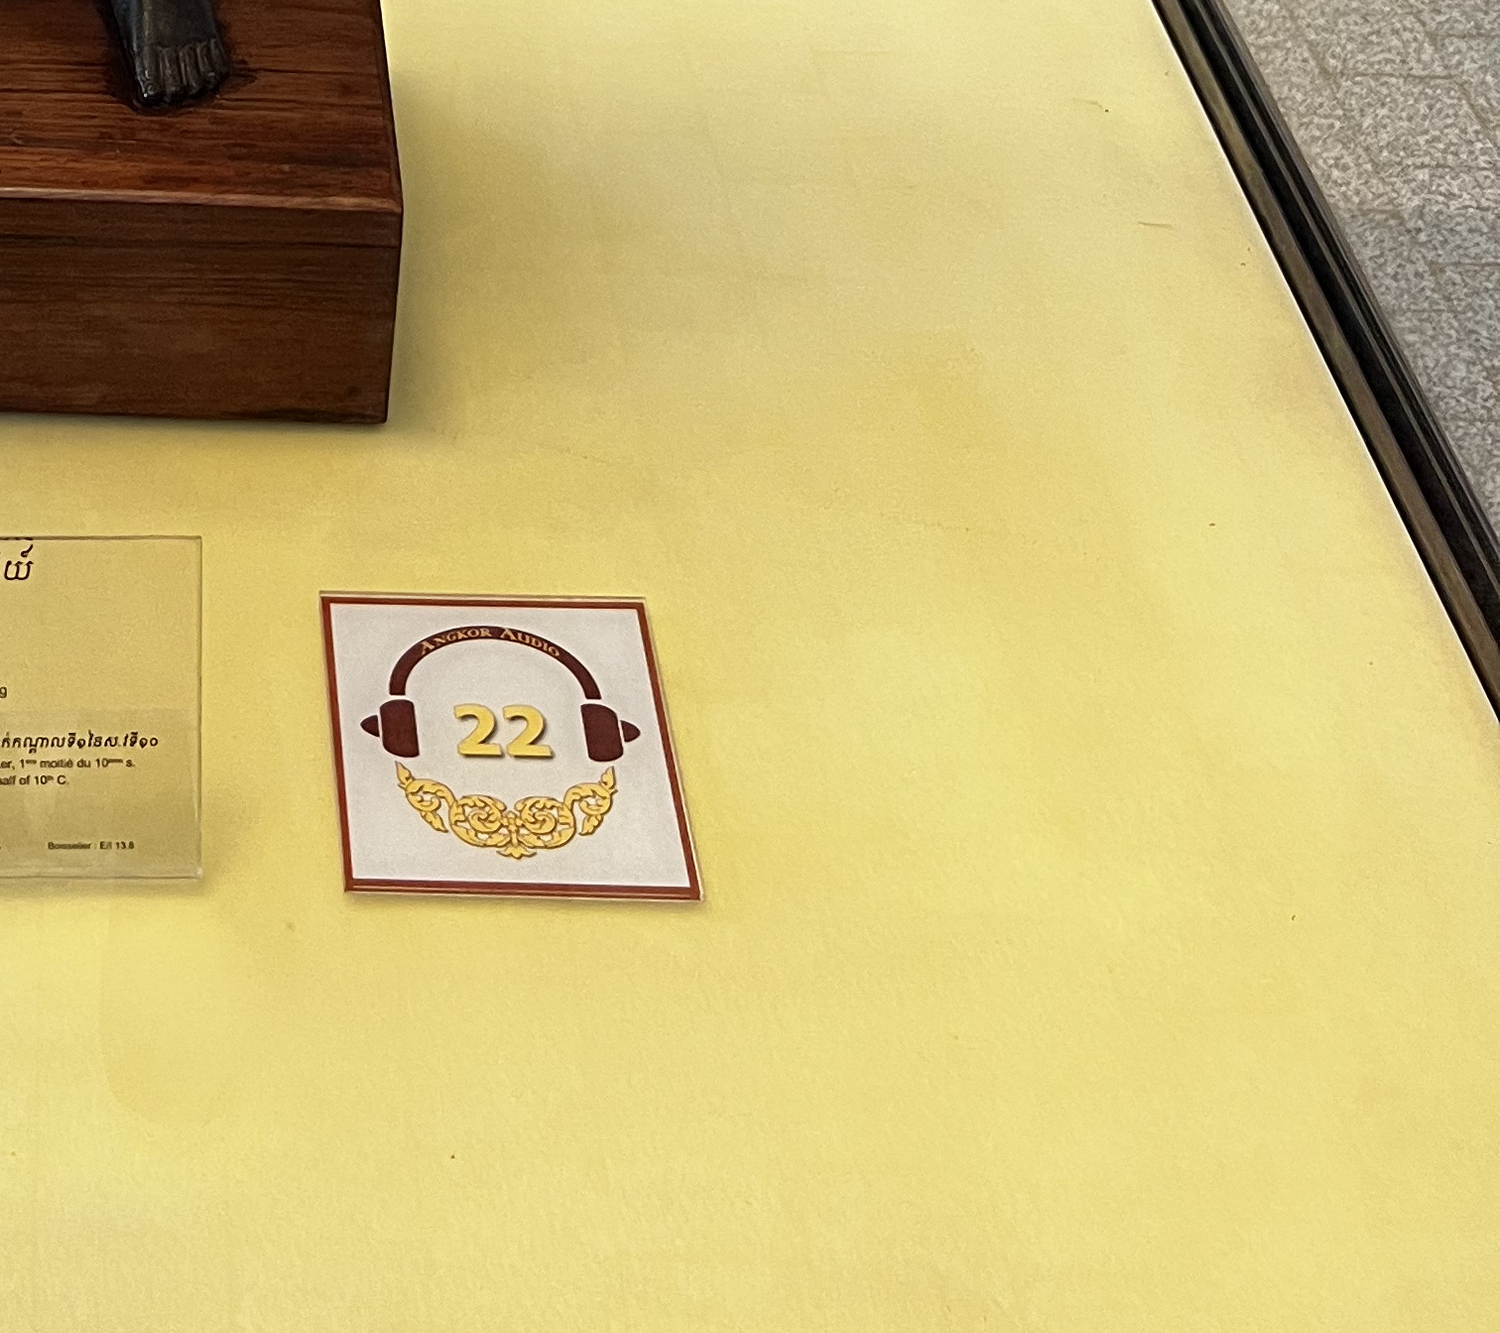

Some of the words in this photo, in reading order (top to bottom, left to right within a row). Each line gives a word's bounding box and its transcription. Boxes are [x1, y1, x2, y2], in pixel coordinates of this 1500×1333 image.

[453, 703, 553, 759] 22
[77, 758, 92, 768] du
[19, 775, 31, 786] of
